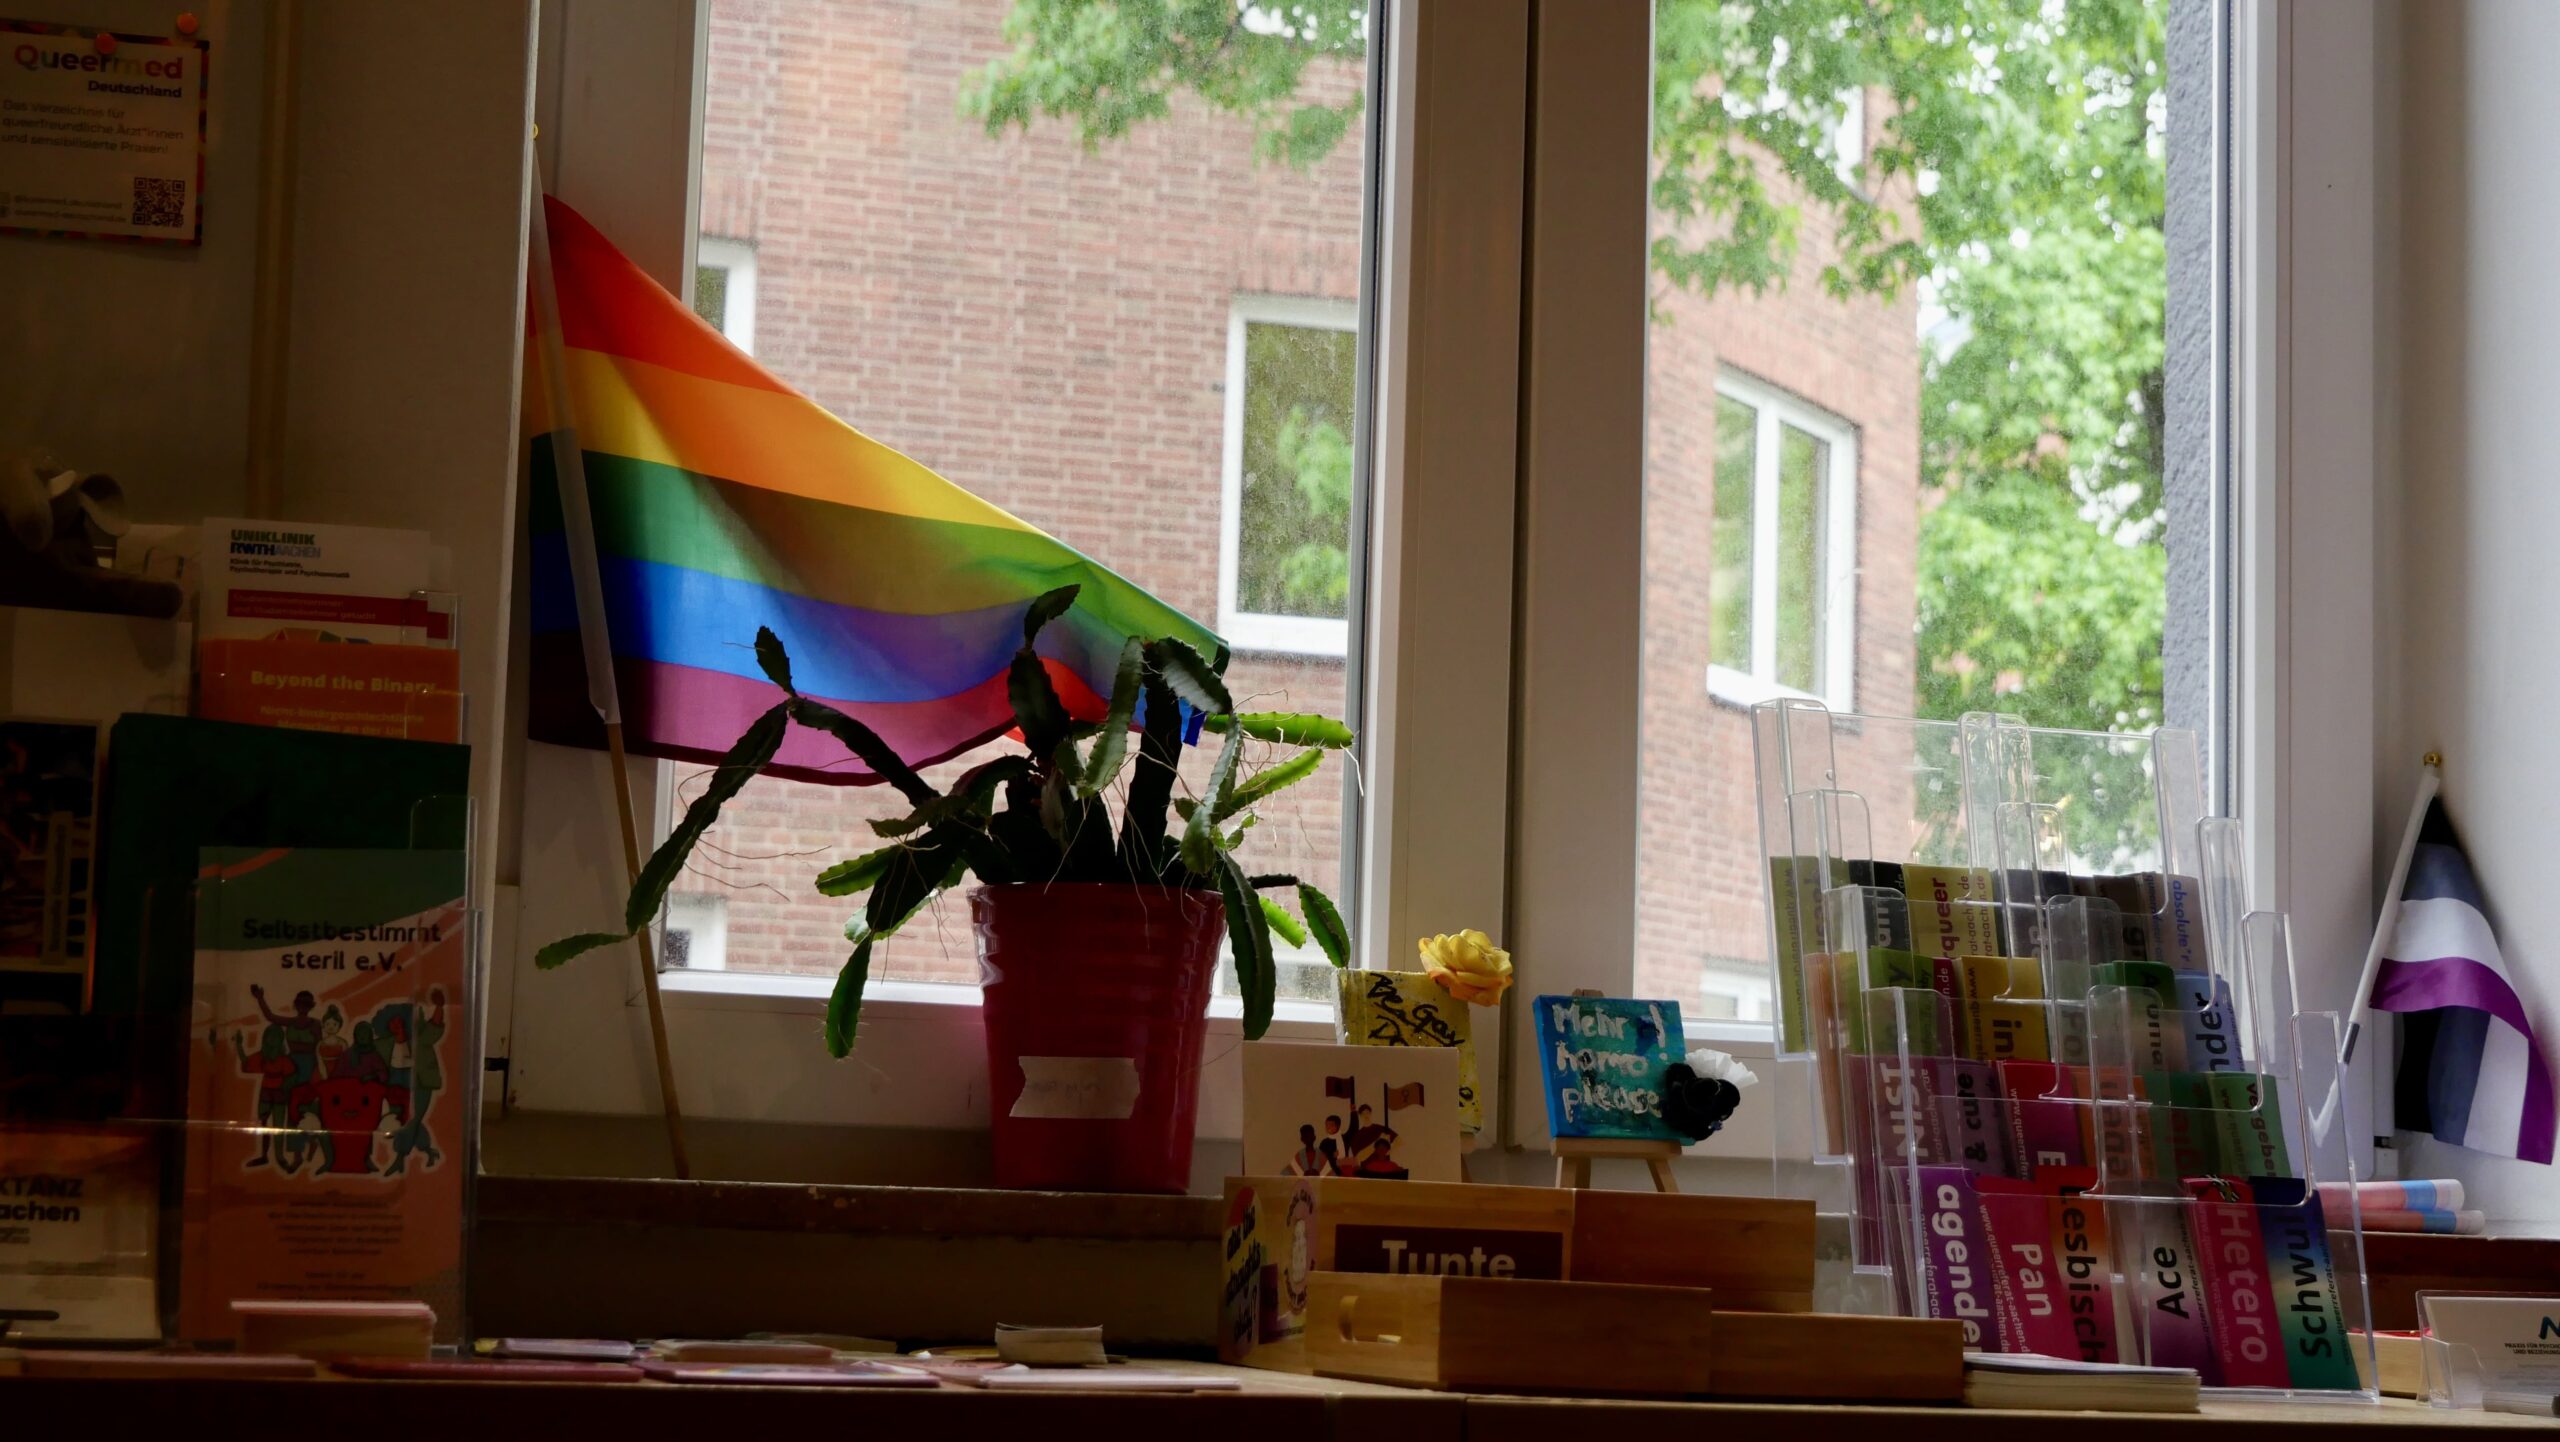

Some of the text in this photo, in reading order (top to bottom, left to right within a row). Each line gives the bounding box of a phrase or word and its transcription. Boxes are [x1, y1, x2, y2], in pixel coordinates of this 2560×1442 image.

[14, 44, 183, 79] Queermed
[88, 80, 182, 98] Deutschland
[230, 529, 316, 545] UNIKLINIK
[251, 670, 437, 693] Beyond the Binary
[243, 918, 441, 942] Selbstbestimmt
[281, 950, 403, 971] steril e.V.
[1552, 1002, 1629, 1041] Mehr
[1555, 1039, 1649, 1077] homo
[1562, 1076, 1663, 1124] please
[2009, 1087, 2029, 1181] www.queerrefer
[1381, 1239, 1518, 1280] Tunte
[1979, 1204, 2031, 1353] www.queerreferat-aachen.d
[2011, 1243, 2052, 1316] Pan
[2059, 1185, 2105, 1362] Lesbisch
[2153, 1246, 2190, 1319] Ace
[2216, 1206, 2269, 1363] Hetero
[2276, 1215, 2332, 1359] Schwul
